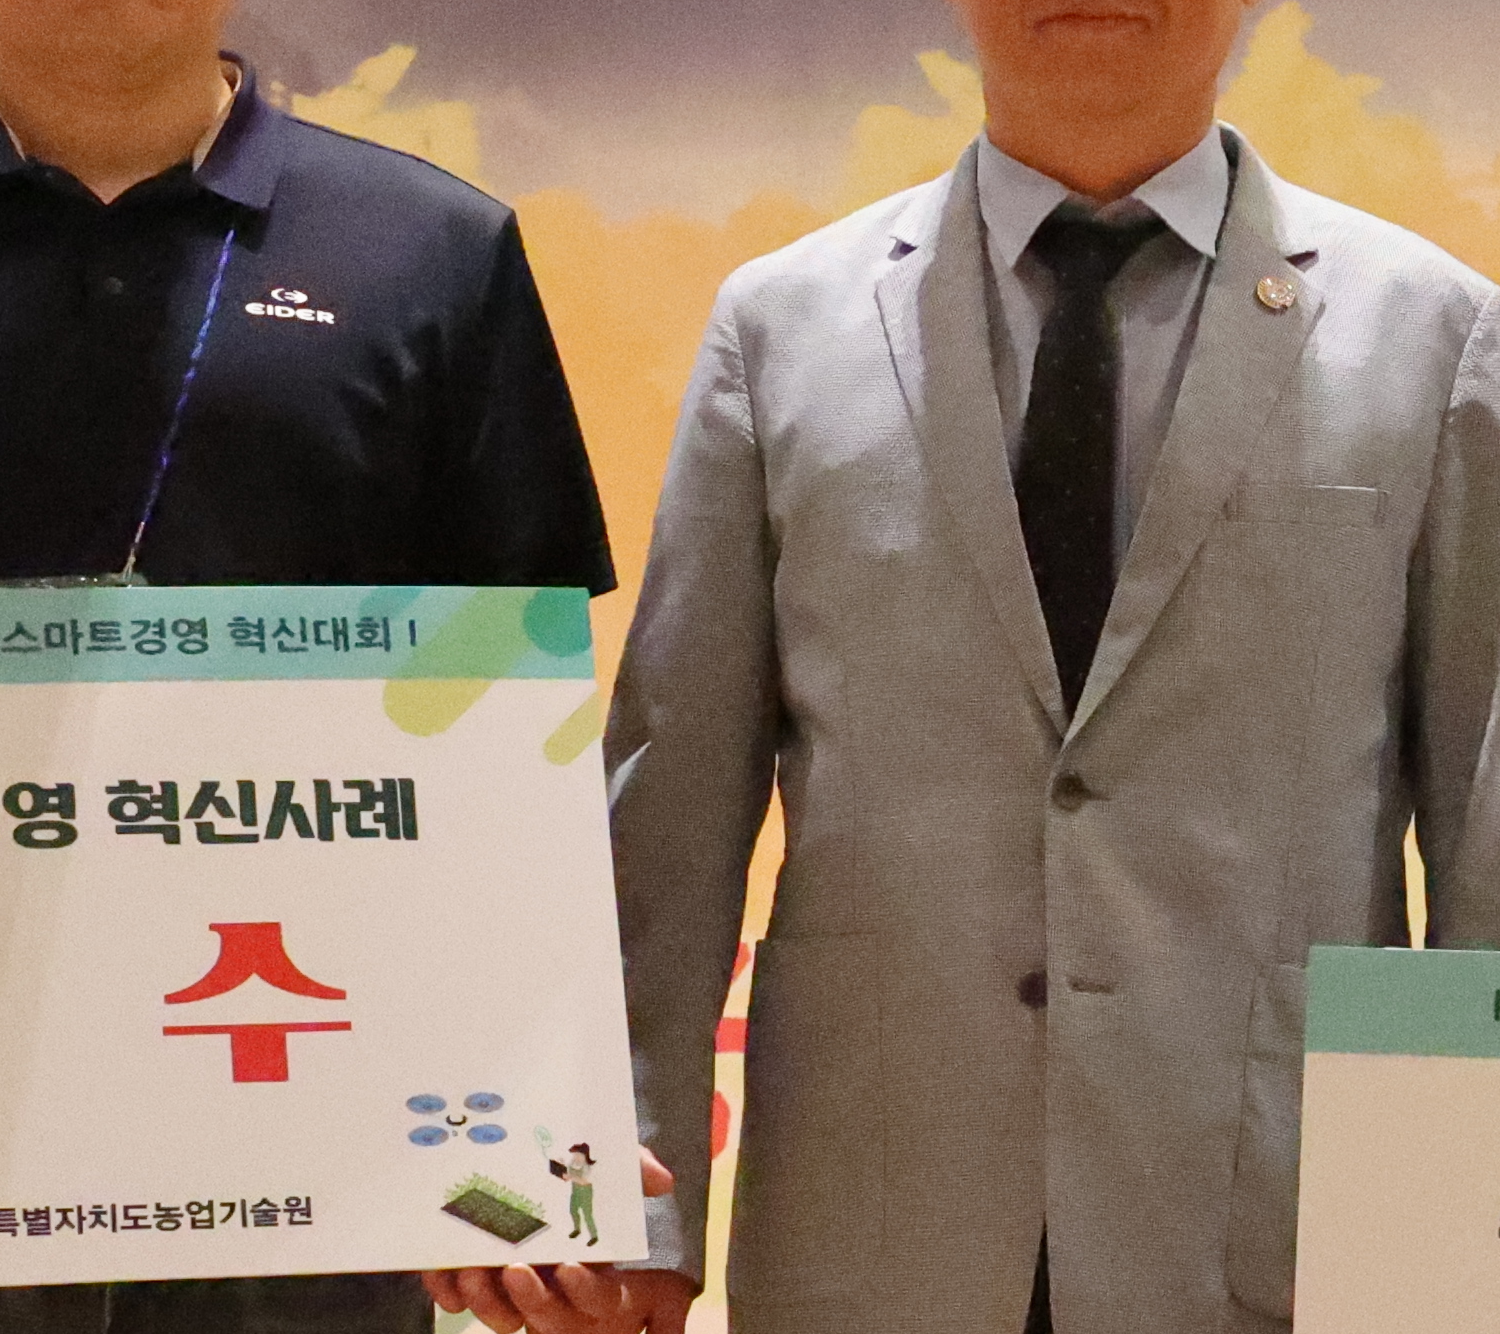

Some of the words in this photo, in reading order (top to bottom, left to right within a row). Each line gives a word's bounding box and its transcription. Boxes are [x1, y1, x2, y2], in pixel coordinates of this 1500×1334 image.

[244, 301, 336, 325] EIDER
[0, 616, 210, 658] 스마트경영
[226, 614, 393, 655] 혁신대회
[103, 776, 420, 847] 혁신사례
